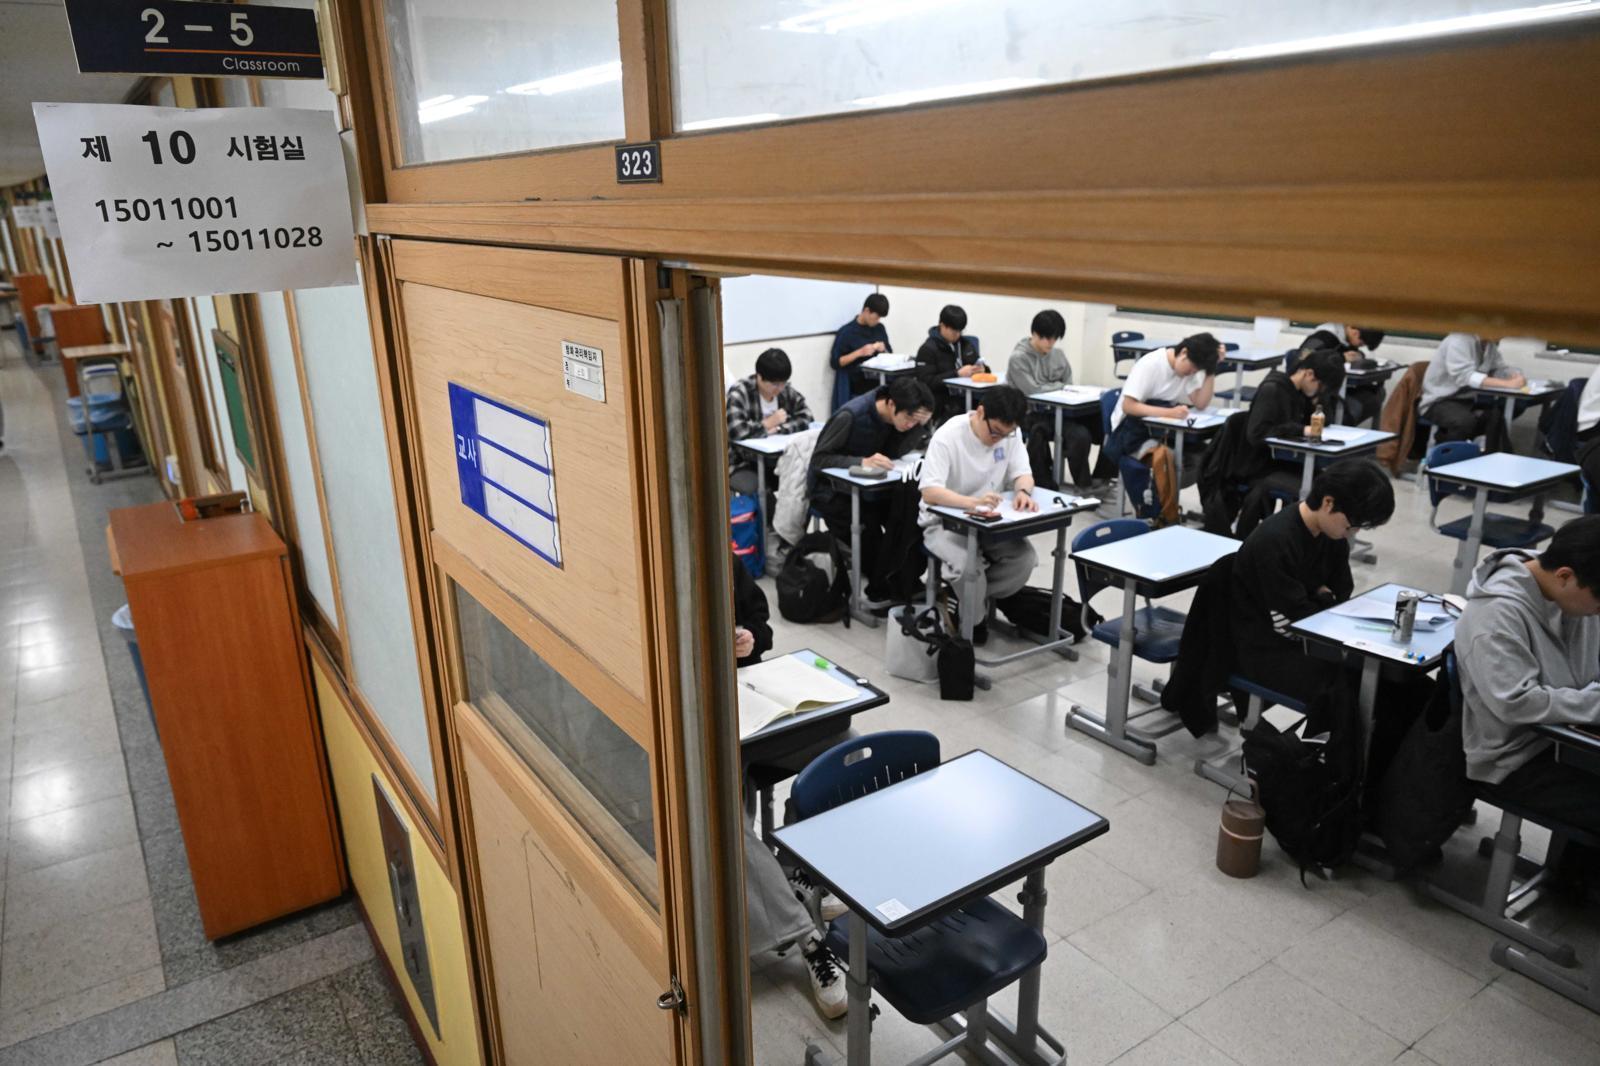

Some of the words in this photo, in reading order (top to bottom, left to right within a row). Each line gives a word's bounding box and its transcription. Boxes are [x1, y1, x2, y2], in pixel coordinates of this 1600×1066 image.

[140, 8, 169, 44] 2
[230, 12, 254, 47] 5
[222, 56, 301, 72] Classroom
[80, 135, 112, 163] 제
[141, 130, 197, 165] 10
[226, 135, 306, 162] 시험실
[621, 150, 652, 176] 323
[95, 196, 238, 223] 15011001
[188, 226, 323, 253] 15011028
[456, 433, 477, 468] 교사
